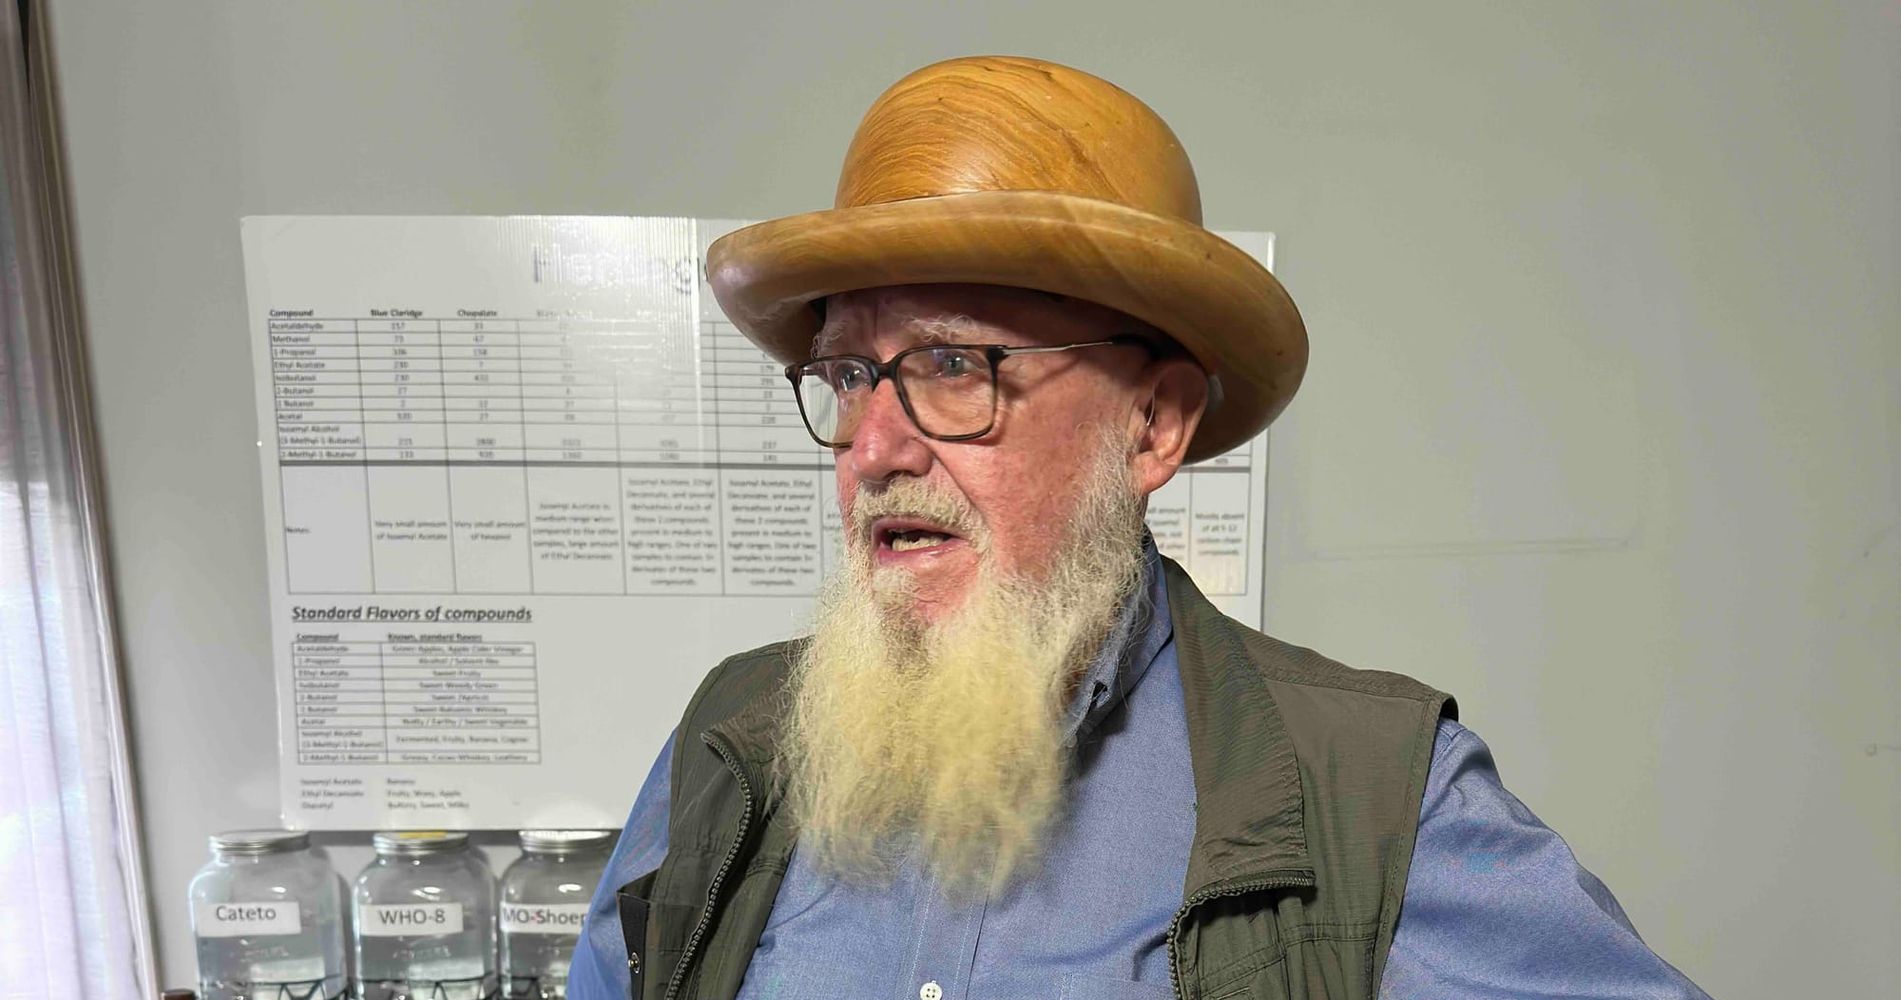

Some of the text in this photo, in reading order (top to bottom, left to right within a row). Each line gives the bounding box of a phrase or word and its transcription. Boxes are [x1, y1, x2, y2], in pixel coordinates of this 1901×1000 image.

[292, 606, 532, 622] Standard Flavors of compounds
[216, 905, 277, 921] Cateto
[379, 909, 446, 925] WHO-8
